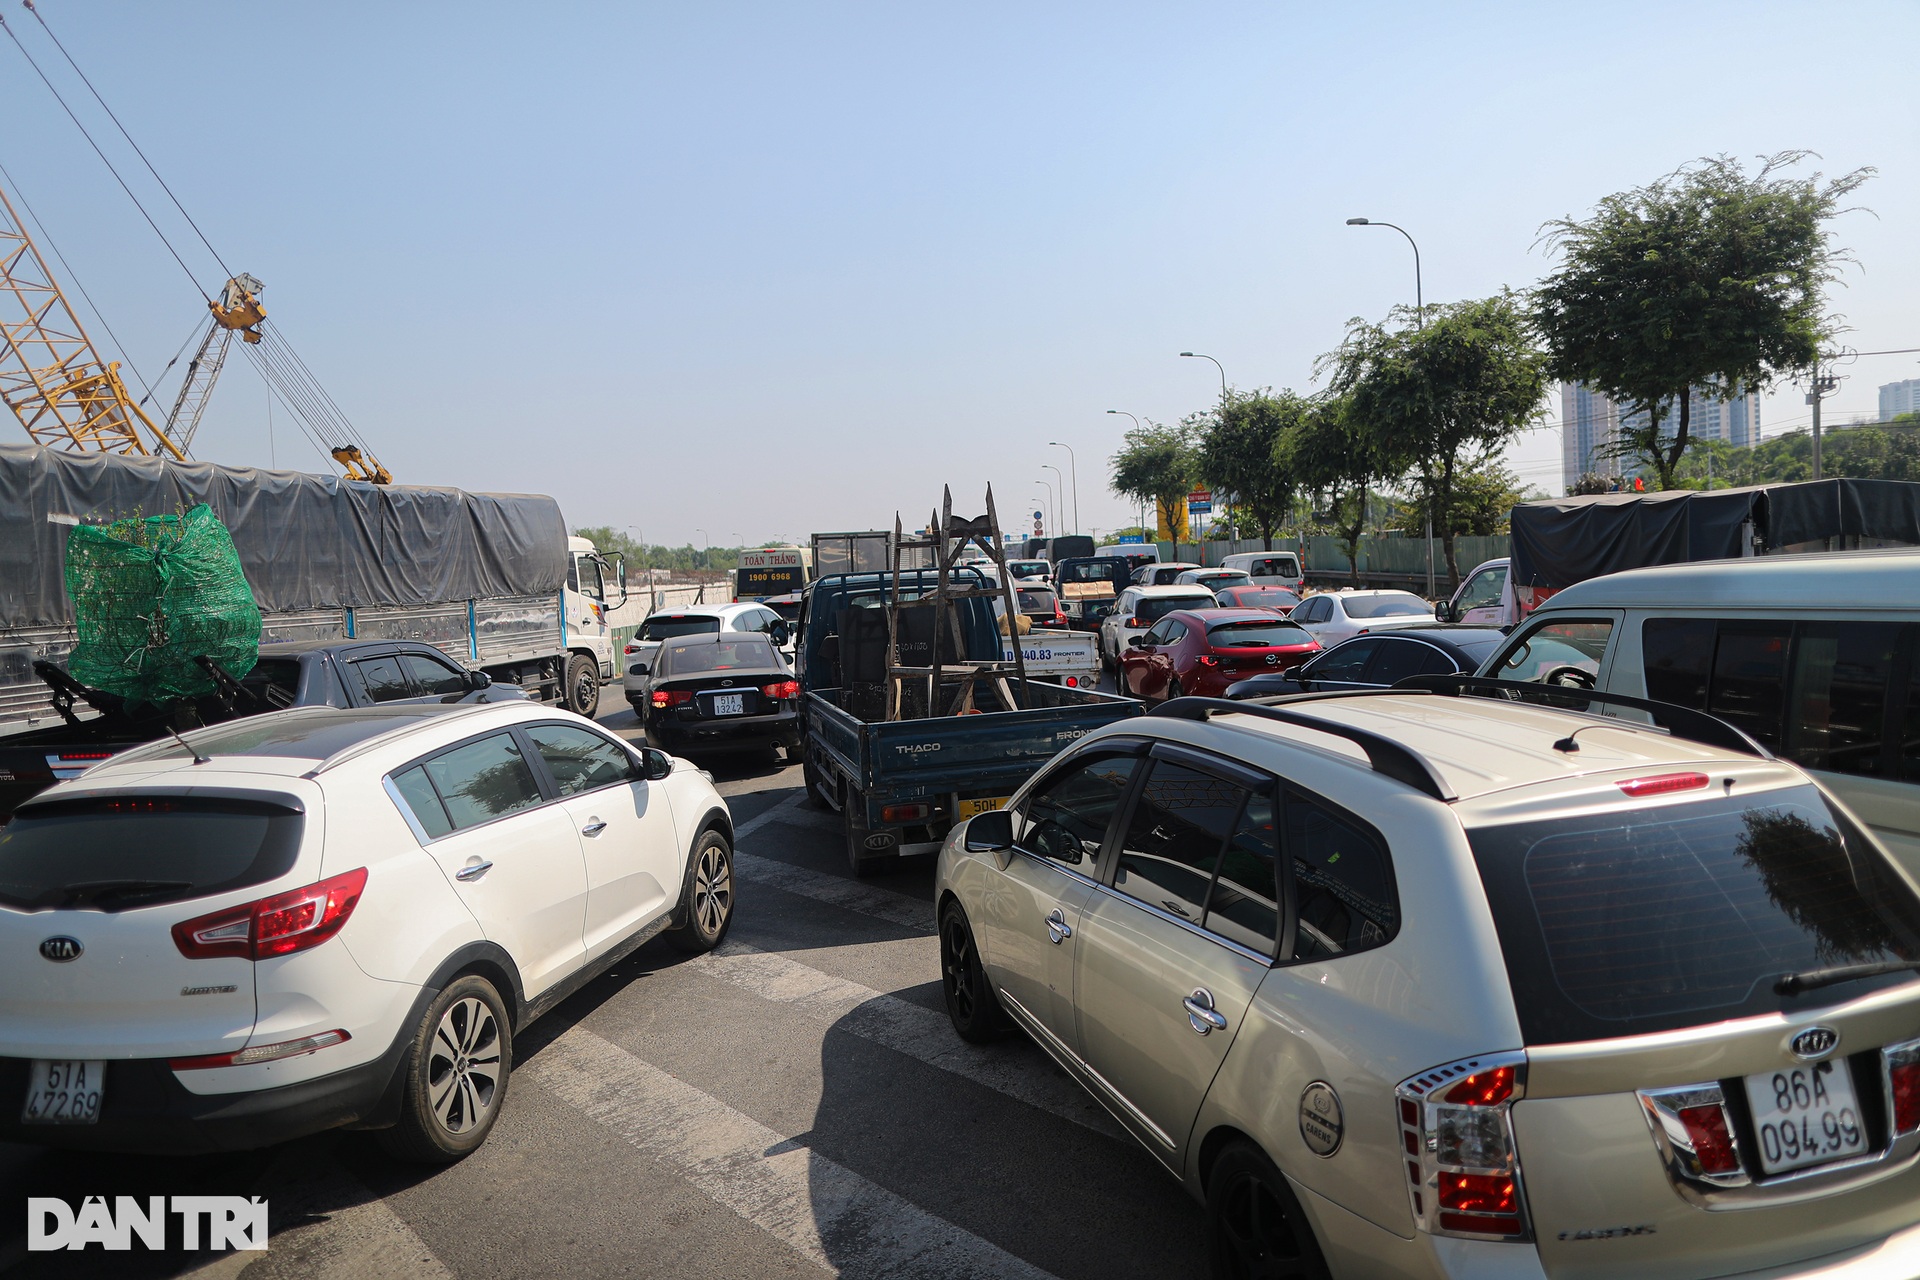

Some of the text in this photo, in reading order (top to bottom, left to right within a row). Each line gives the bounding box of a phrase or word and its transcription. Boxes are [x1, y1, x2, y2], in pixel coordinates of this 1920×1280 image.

[744, 554, 765, 565] TOÀN
[769, 552, 796, 565] THẮNG
[749, 573, 791, 581] 1900 6968
[720, 696, 736, 705] 51A
[716, 704, 742, 714] 132.42
[1056, 729, 1096, 739] FRON
[896, 743, 941, 754] THACO
[974, 800, 997, 812] 50H
[869, 837, 891, 847] KIA
[44, 942, 75, 957] KIA
[1799, 1031, 1831, 1052] KIA
[48, 1062, 86, 1089] 51A
[1772, 1065, 1830, 1114] 86A
[28, 1091, 99, 1119] 472.69
[1305, 1122, 1331, 1144] CARENS
[1761, 1107, 1860, 1164] 094.99
